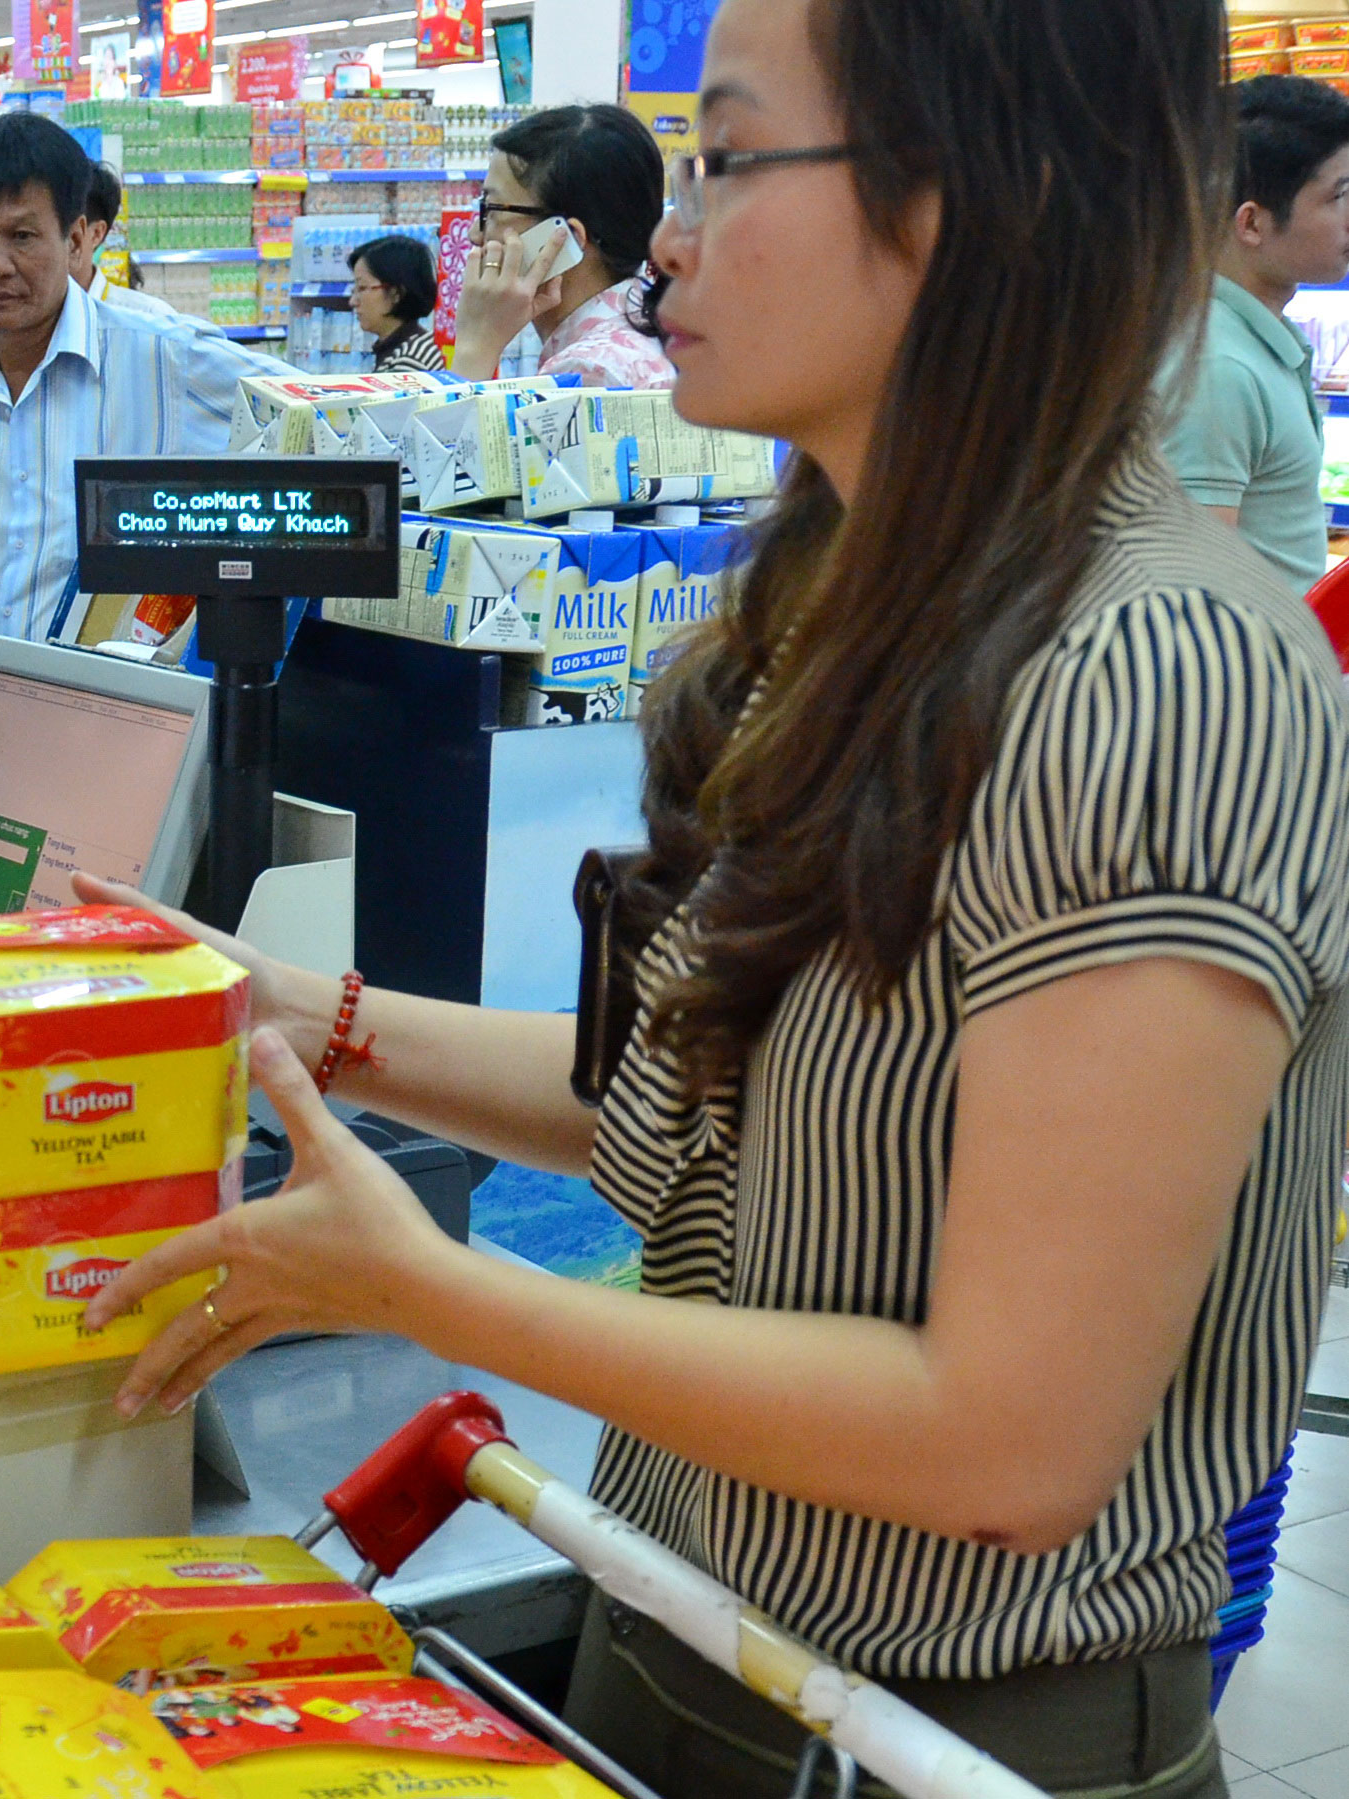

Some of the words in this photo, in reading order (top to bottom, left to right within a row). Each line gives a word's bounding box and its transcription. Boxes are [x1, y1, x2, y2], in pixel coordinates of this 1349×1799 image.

[153, 490, 262, 511] Co.opMart
[273, 490, 312, 511] LTK
[118, 512, 168, 532] Chao
[178, 512, 228, 532] Mung
[237, 513, 277, 533] Quy
[285, 513, 349, 534] Khach
[554, 591, 629, 630] Milk
[648, 585, 719, 624] Milk
[562, 632, 584, 641] FULL
[585, 630, 619, 641] CREAM
[553, 654, 592, 674] 100%
[593, 647, 627, 668] PURE
[50, 1090, 130, 1119] Lipton
[31, 1135, 95, 1154] YELLOW
[101, 1130, 147, 1150] LABEL
[77, 1151, 105, 1164] TEA
